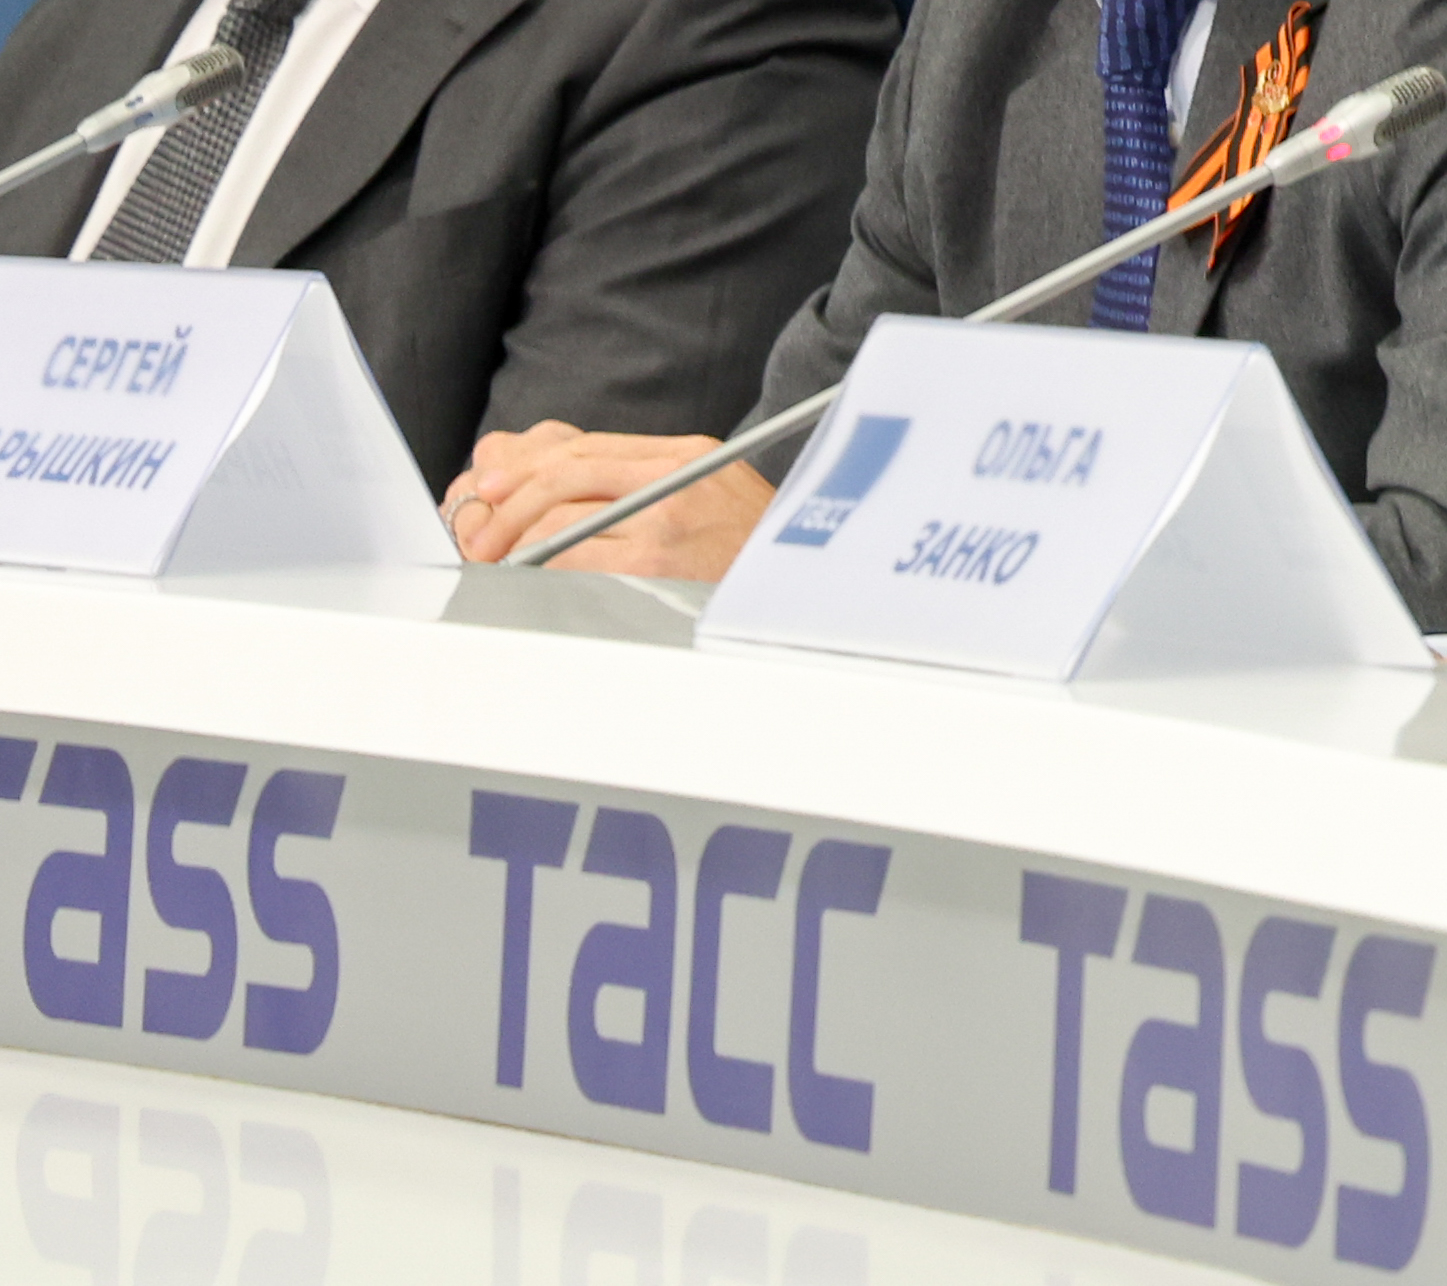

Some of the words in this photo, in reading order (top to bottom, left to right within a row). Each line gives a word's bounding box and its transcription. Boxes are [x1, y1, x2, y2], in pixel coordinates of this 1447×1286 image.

[40, 325, 194, 397] СЕРГЕЙ
[0, 429, 177, 492] РЫШКИН
[973, 419, 1106, 487] ОЛЬГА
[893, 520, 1042, 586] ЗАНКО
